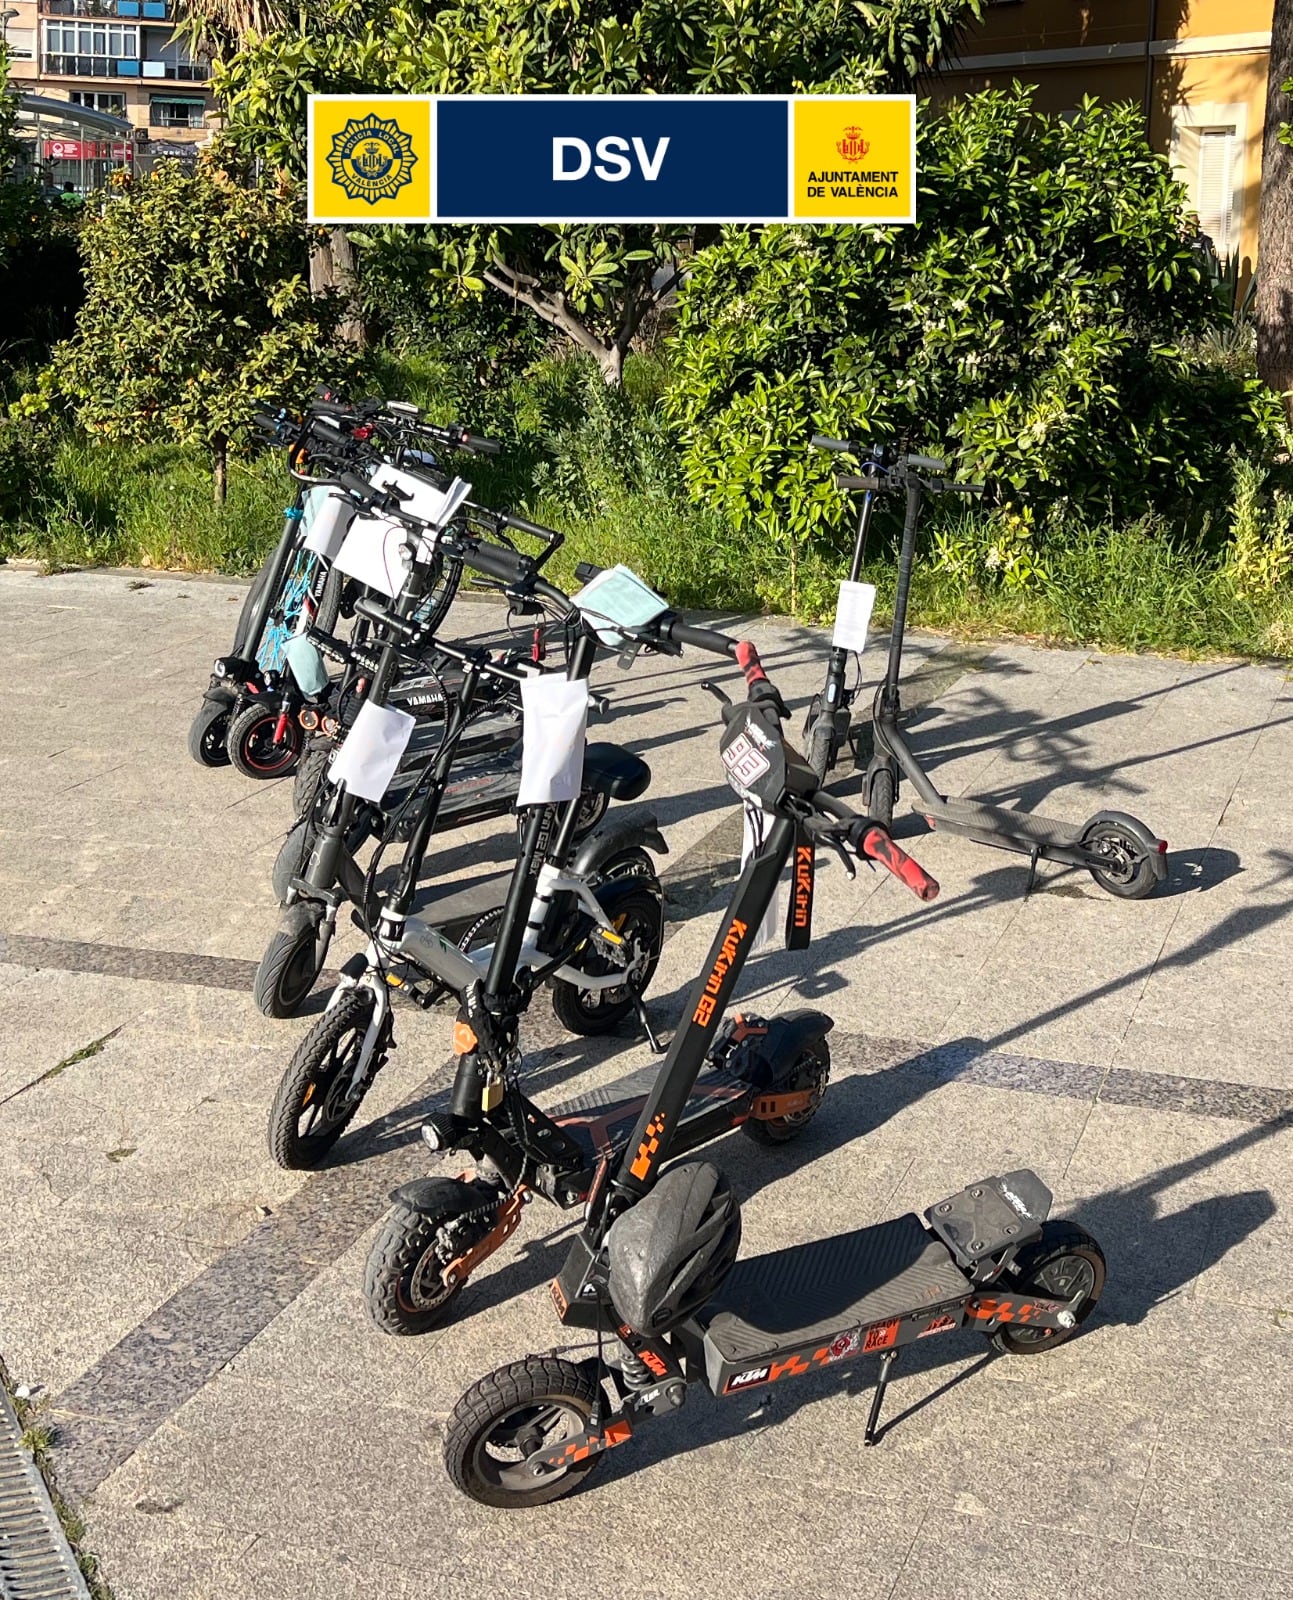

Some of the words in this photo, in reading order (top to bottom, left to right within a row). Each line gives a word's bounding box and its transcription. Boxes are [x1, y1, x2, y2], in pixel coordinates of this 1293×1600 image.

[314, 571, 328, 597] YAMAHA
[406, 693, 444, 707] YAMAHA
[721, 732, 770, 789] 93
[692, 994, 717, 1028] G2
[864, 1335, 888, 1350] RACE
[638, 1350, 668, 1377] KTM
[731, 1368, 768, 1386] KTM
